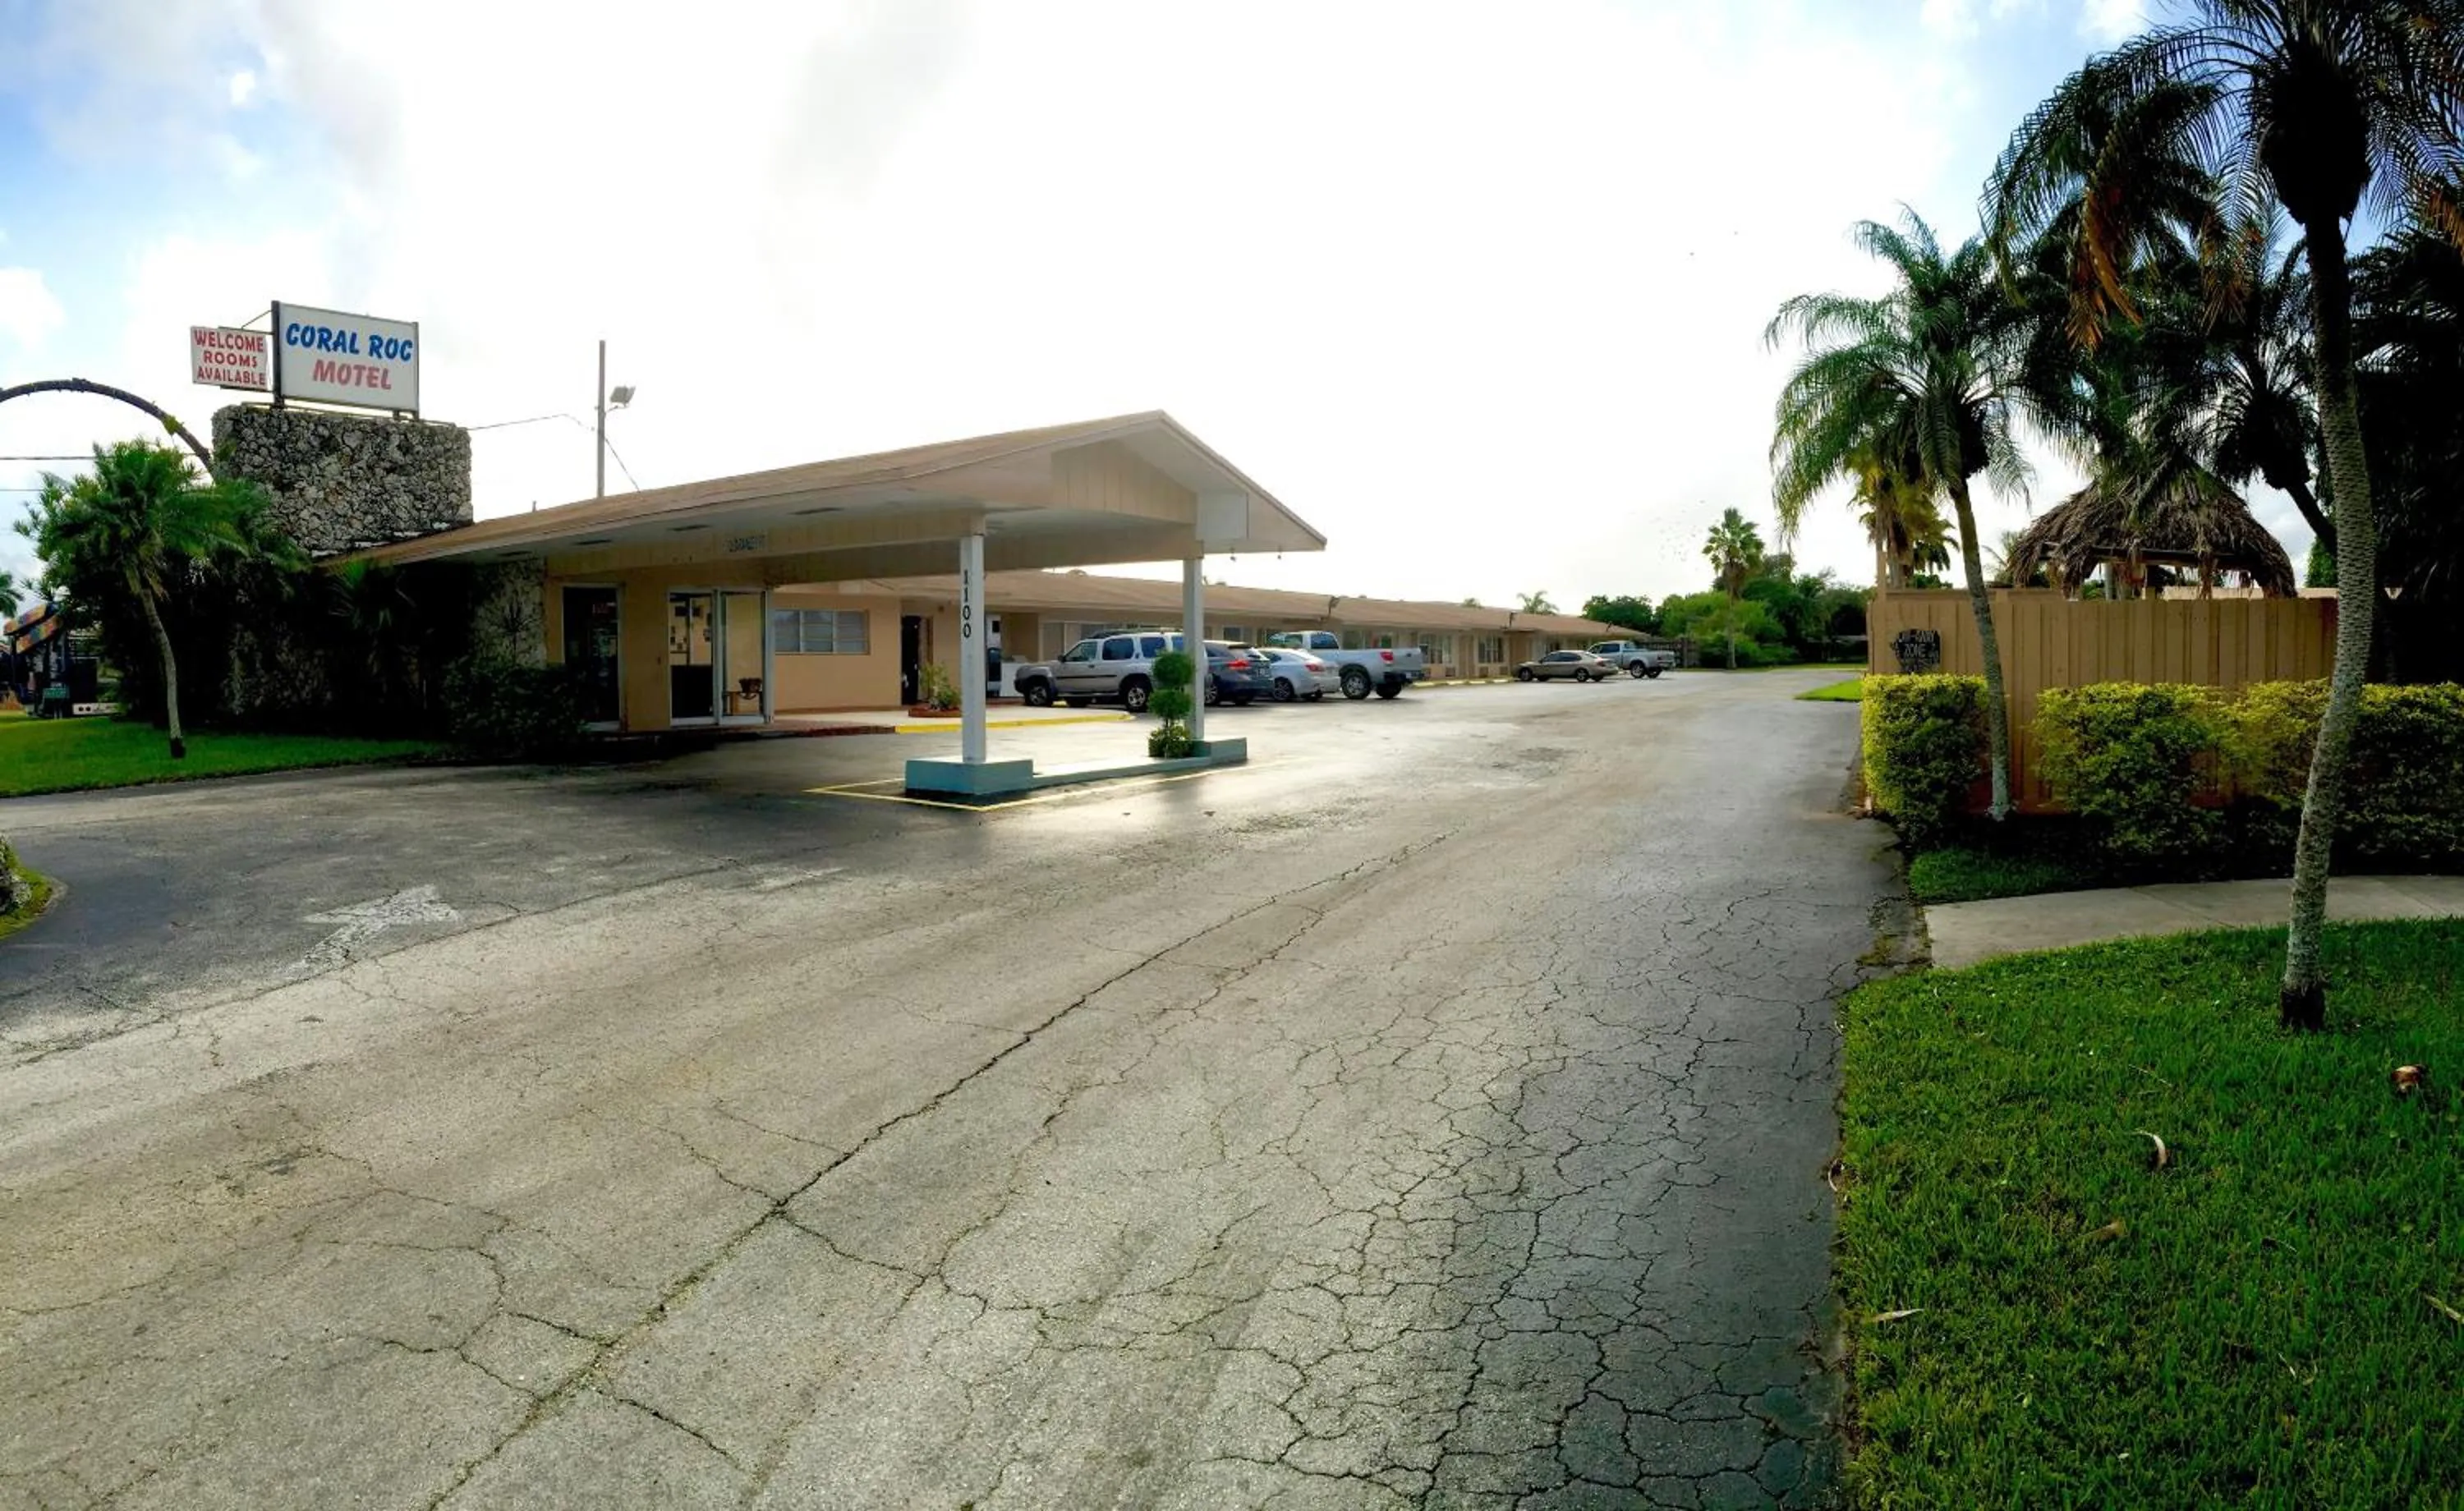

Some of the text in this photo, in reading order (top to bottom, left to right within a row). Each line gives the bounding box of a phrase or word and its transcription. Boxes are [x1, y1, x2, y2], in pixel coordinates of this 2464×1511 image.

[194, 330, 264, 352] WELCOME
[285, 323, 413, 361] CORAL ROC
[203, 350, 258, 368] ROOMS
[197, 365, 265, 385] AVAILABLE
[312, 359, 392, 390] MOTEL
[963, 569, 972, 638] 1100
